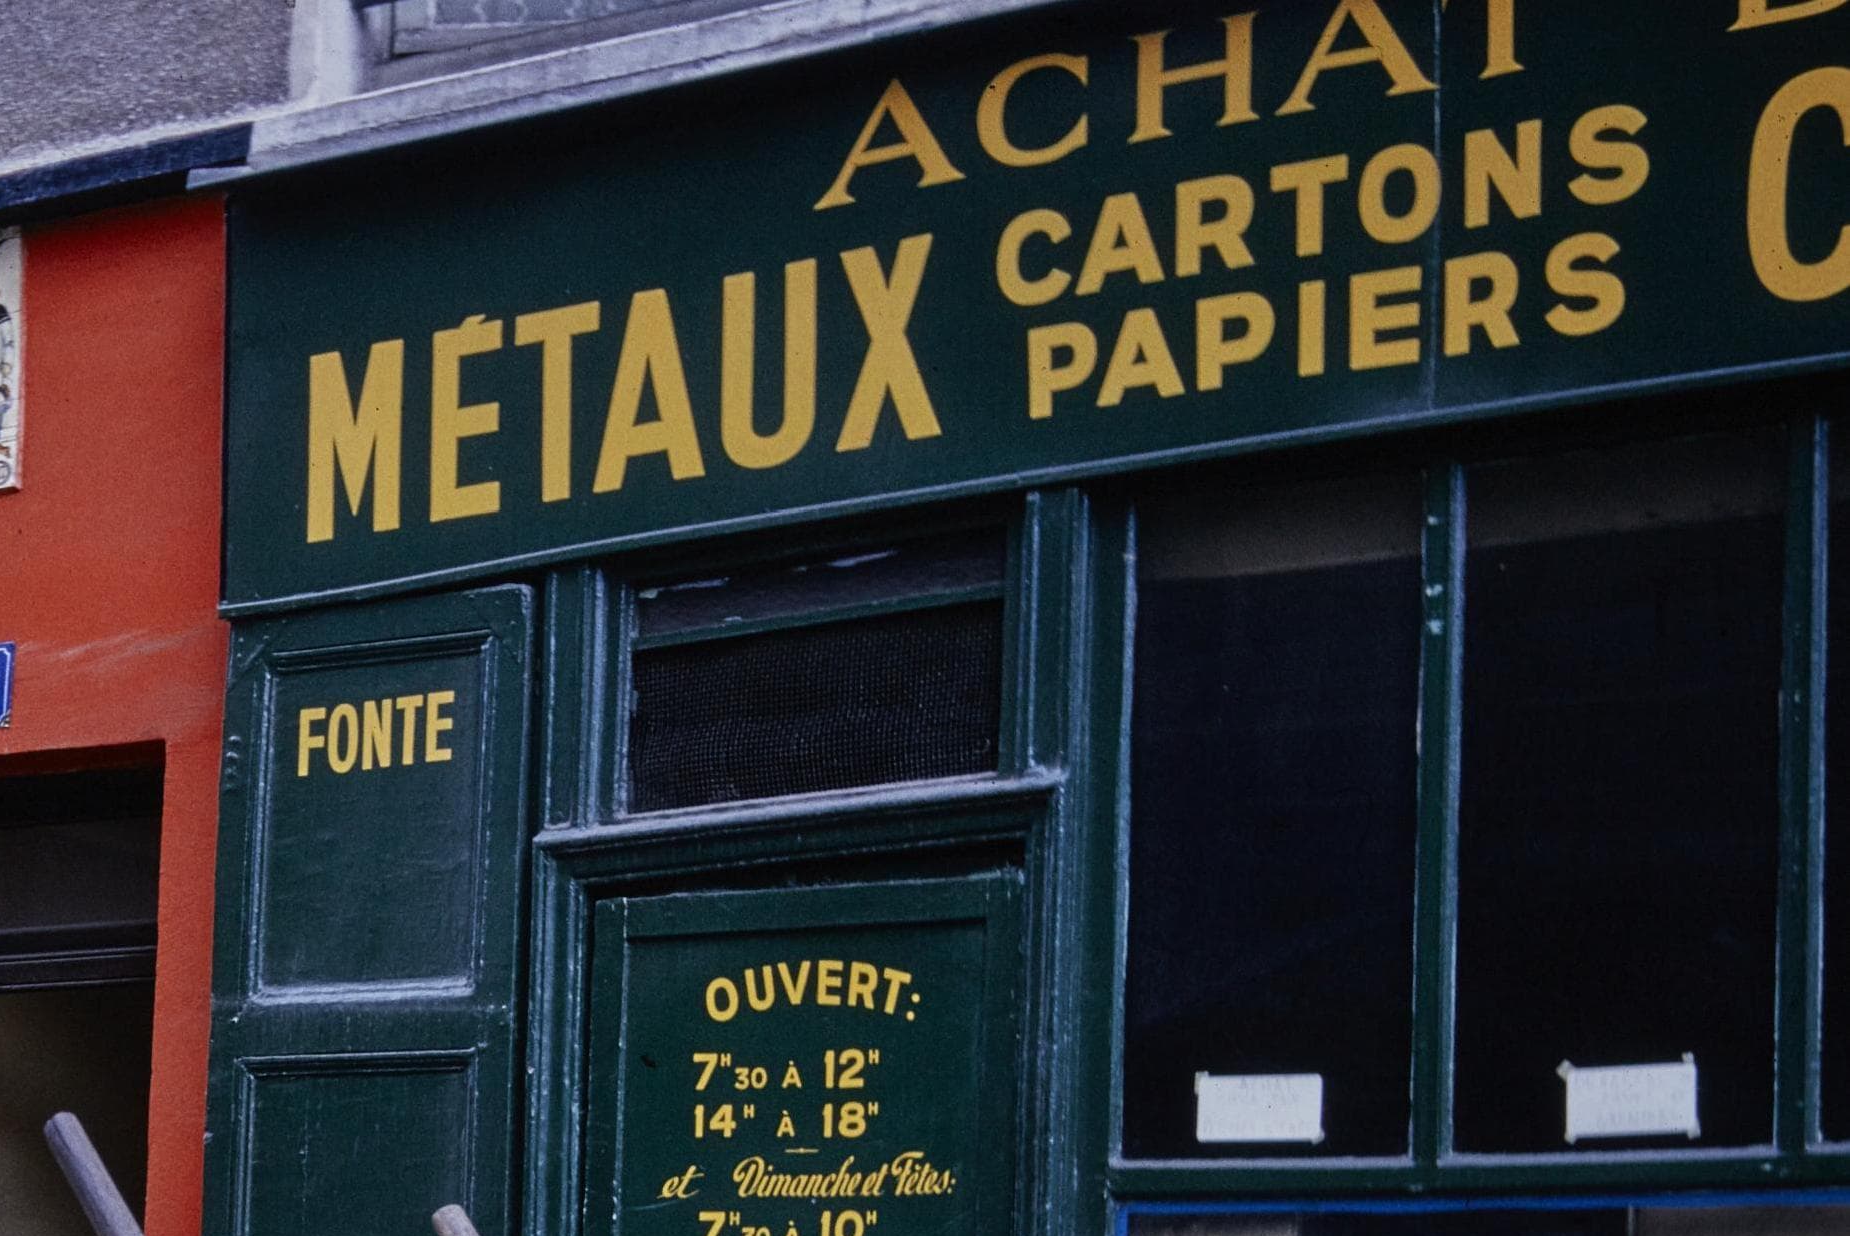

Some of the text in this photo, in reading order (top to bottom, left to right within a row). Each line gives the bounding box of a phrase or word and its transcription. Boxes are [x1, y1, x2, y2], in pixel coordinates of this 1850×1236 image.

[996, 104, 1650, 307] CARTONS
[306, 233, 943, 544] MÉTAUX
[1028, 232, 1626, 420] PAPIERS
[297, 690, 455, 777] FONTE
[705, 959, 921, 1022] OUVERT:
[657, 1165, 705, 1200] et
[733, 1156, 861, 1198] Dimanche
[861, 1163, 888, 1198] et
